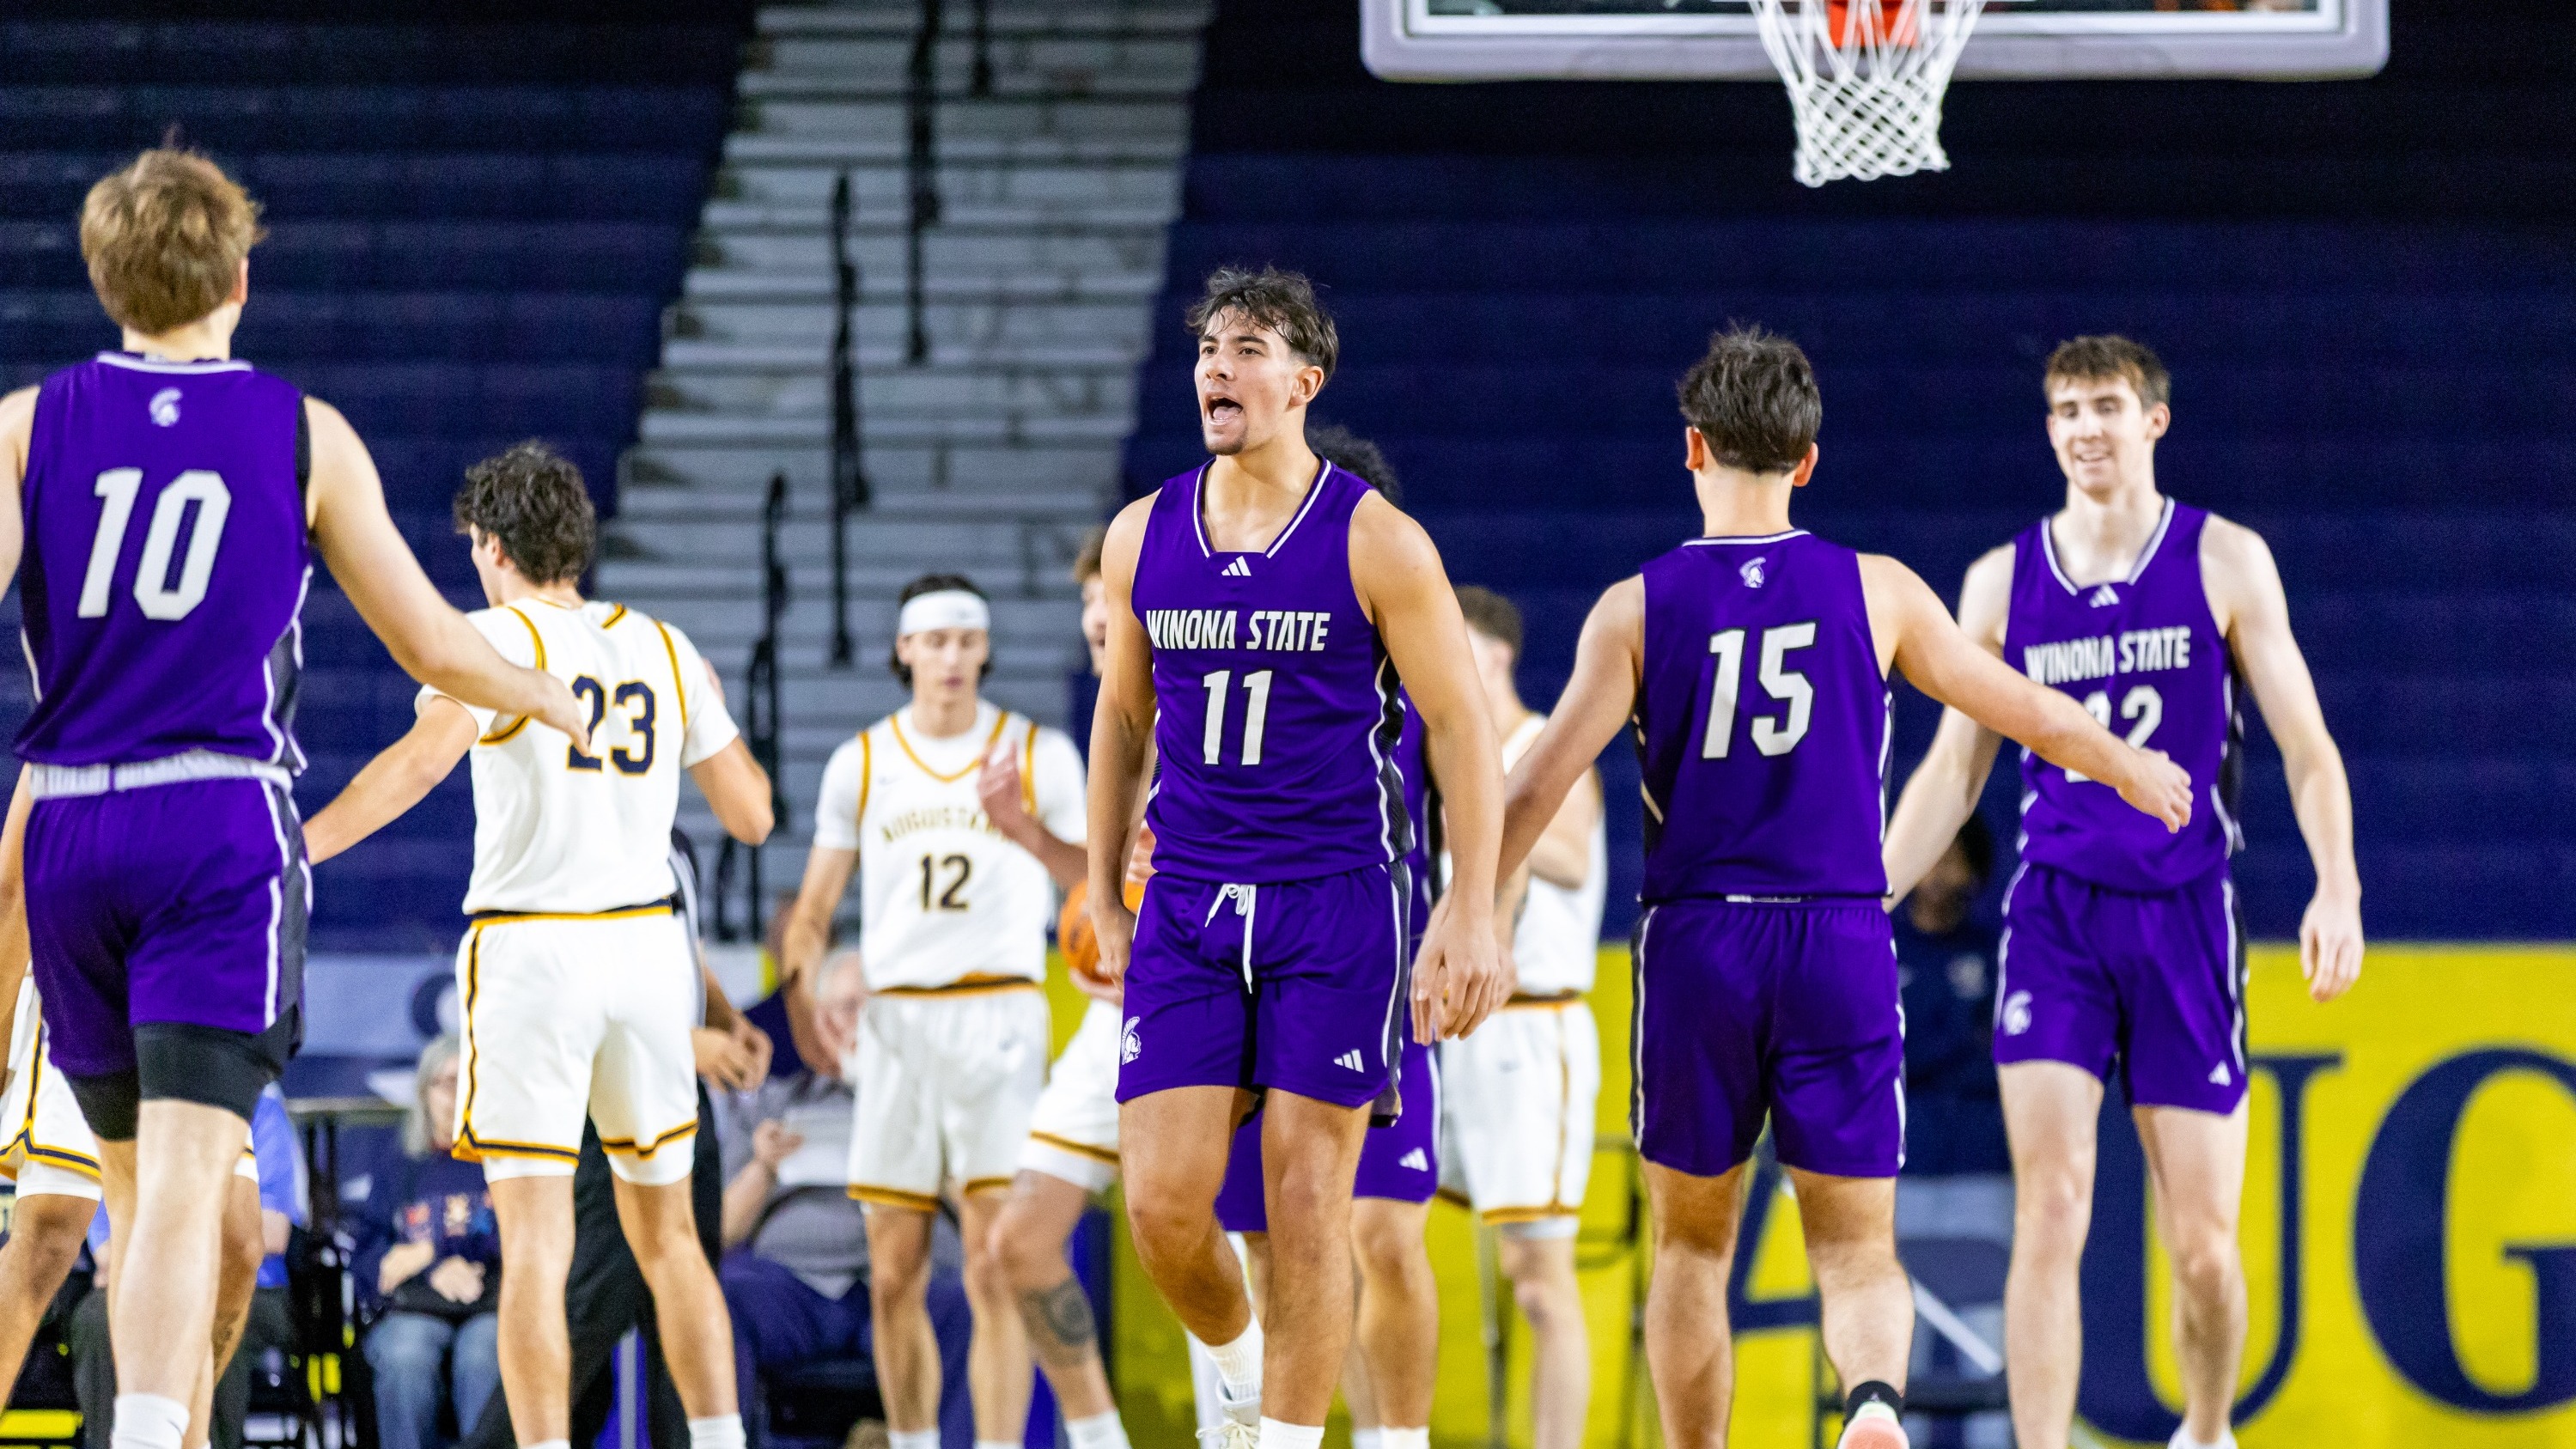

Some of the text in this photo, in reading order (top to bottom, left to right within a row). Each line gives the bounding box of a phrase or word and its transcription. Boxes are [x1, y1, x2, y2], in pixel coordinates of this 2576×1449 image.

[77, 466, 232, 621] 10
[1146, 609, 1331, 651] WINONA STATE
[2024, 625, 2191, 685] WINONA STATE
[566, 673, 657, 776] 23
[1203, 670, 1273, 765] 11
[1702, 622, 1817, 759] 15
[921, 853, 971, 912] 12
